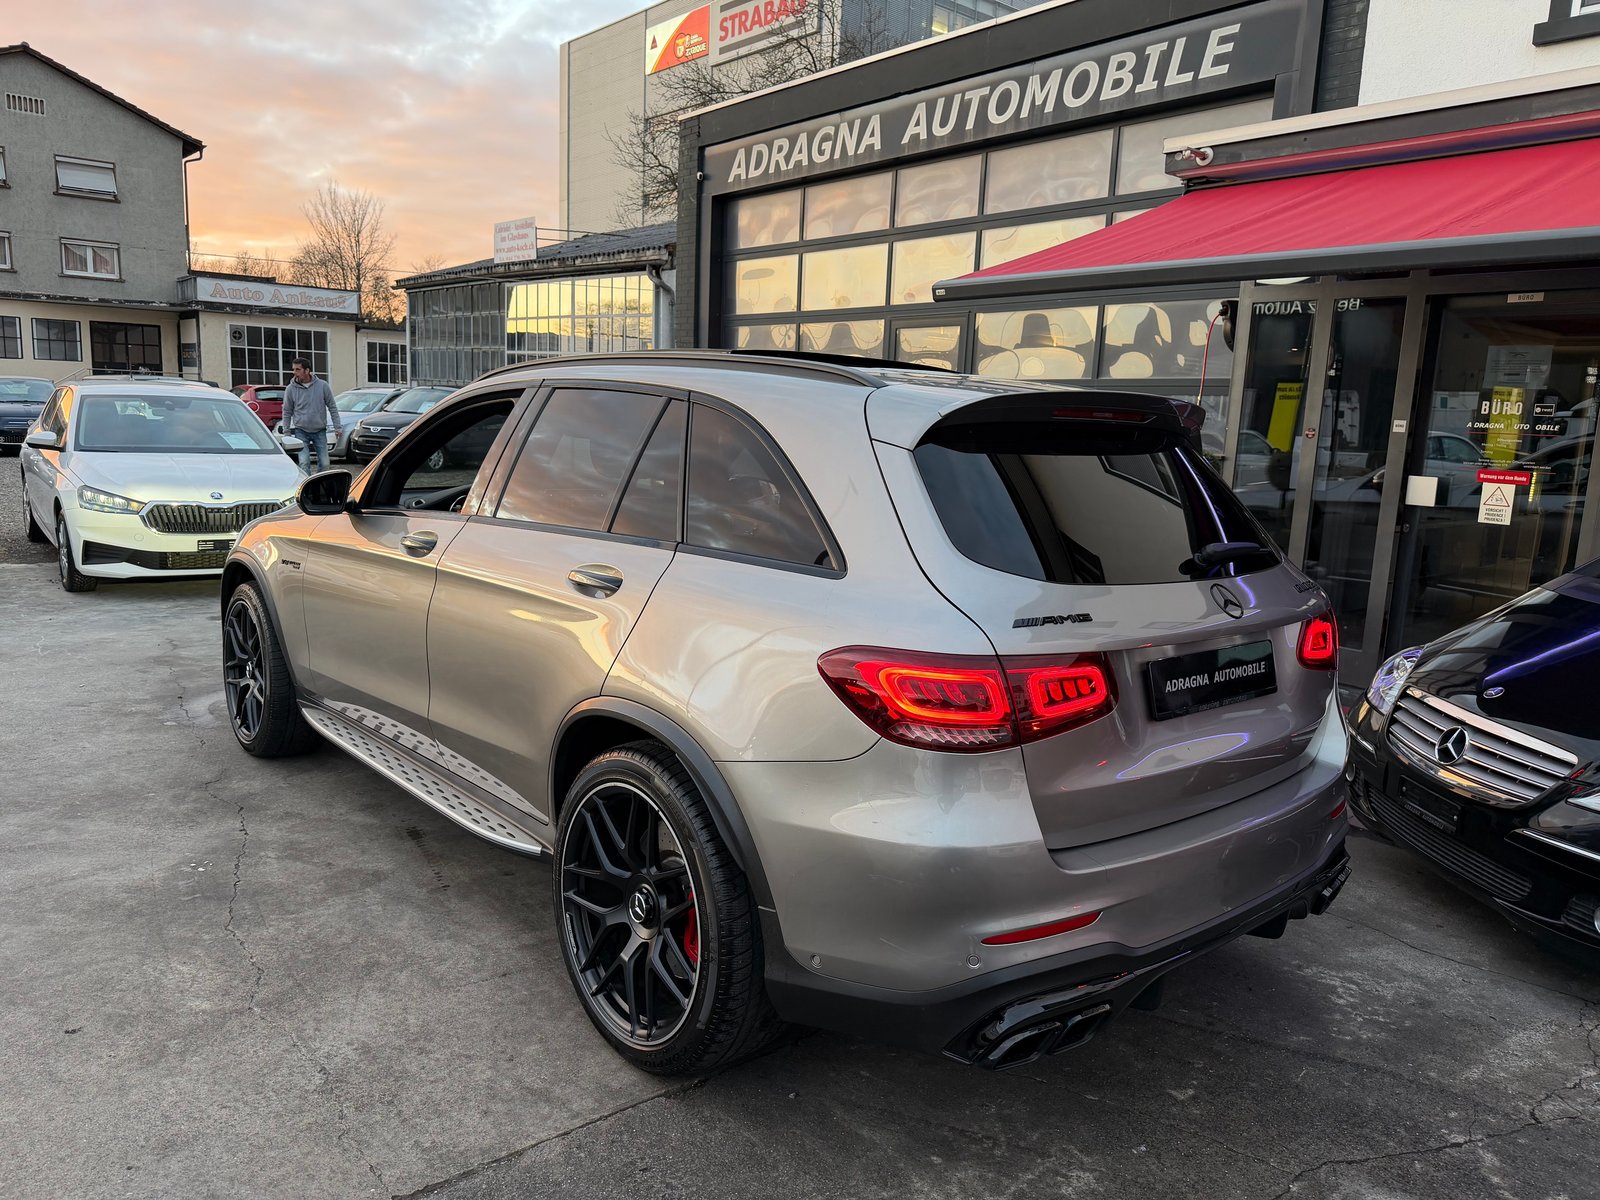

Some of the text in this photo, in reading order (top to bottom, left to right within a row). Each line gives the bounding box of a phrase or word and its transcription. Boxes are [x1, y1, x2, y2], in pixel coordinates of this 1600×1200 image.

[728, 22, 1242, 184] ADRAGNA AUTOMOBILE
[210, 282, 347, 308] Auto Ankauf
[1480, 400, 1524, 415] BÜRO
[1165, 661, 1266, 693] ADRAGNA AUTOMOBILE
